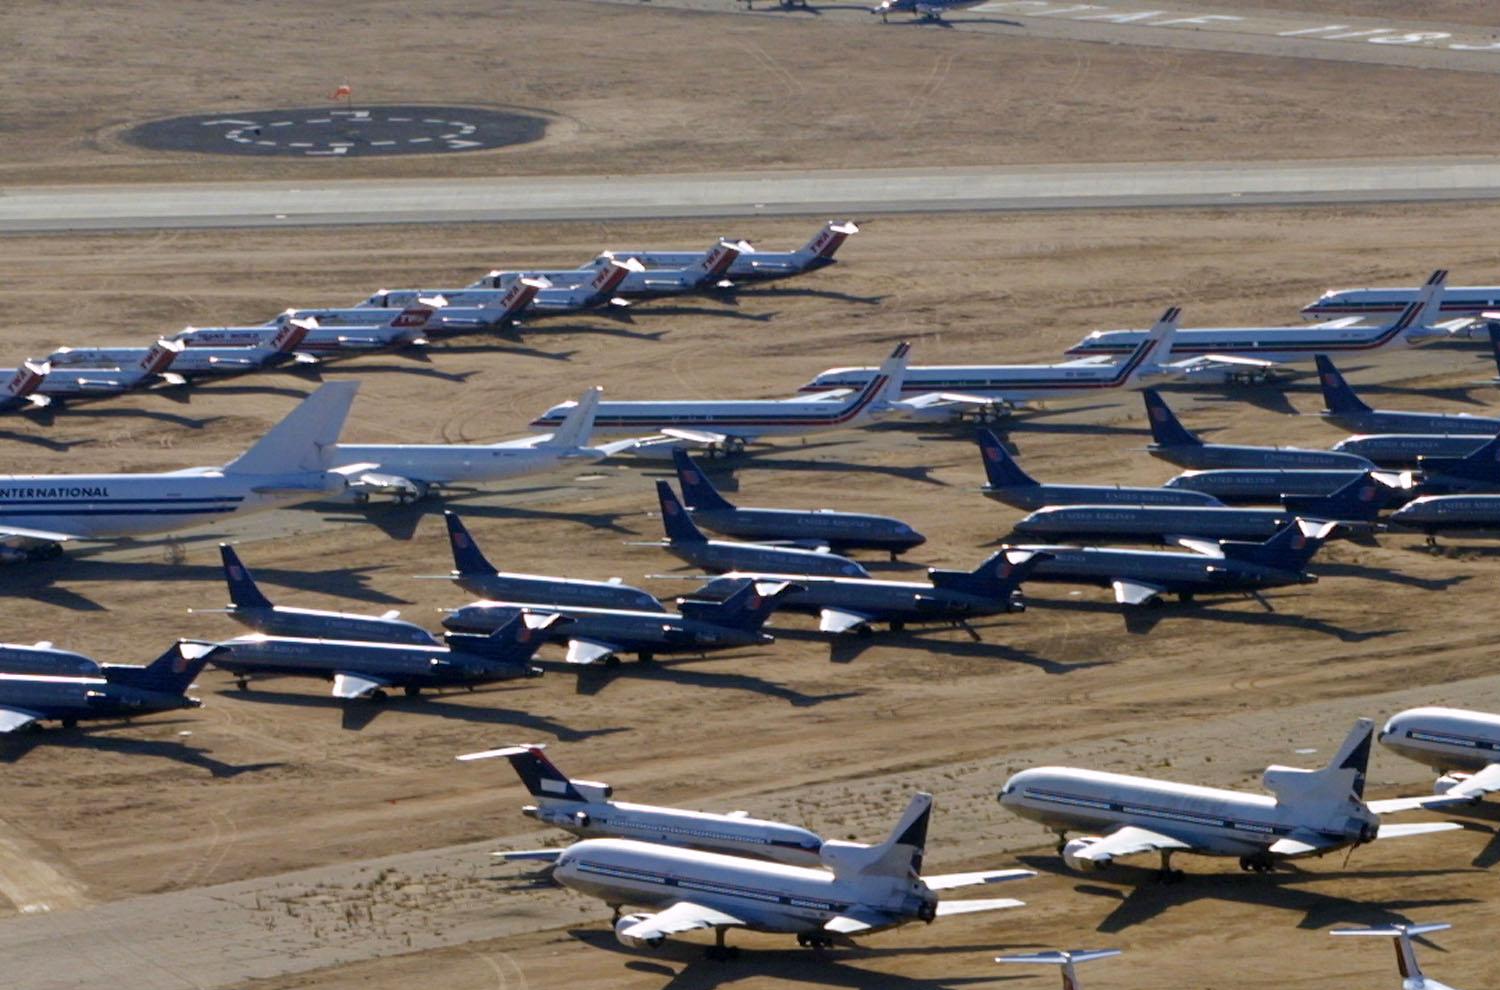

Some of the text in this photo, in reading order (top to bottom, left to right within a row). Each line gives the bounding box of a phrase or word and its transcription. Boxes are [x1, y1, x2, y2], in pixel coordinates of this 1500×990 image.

[810, 231, 830, 254] TWA
[702, 248, 722, 270] TWA
[592, 266, 610, 289] TWA
[500, 285, 520, 308] TWA
[271, 325, 291, 347] TWA
[140, 347, 160, 370] TWA
[8, 368, 28, 393] TWA
